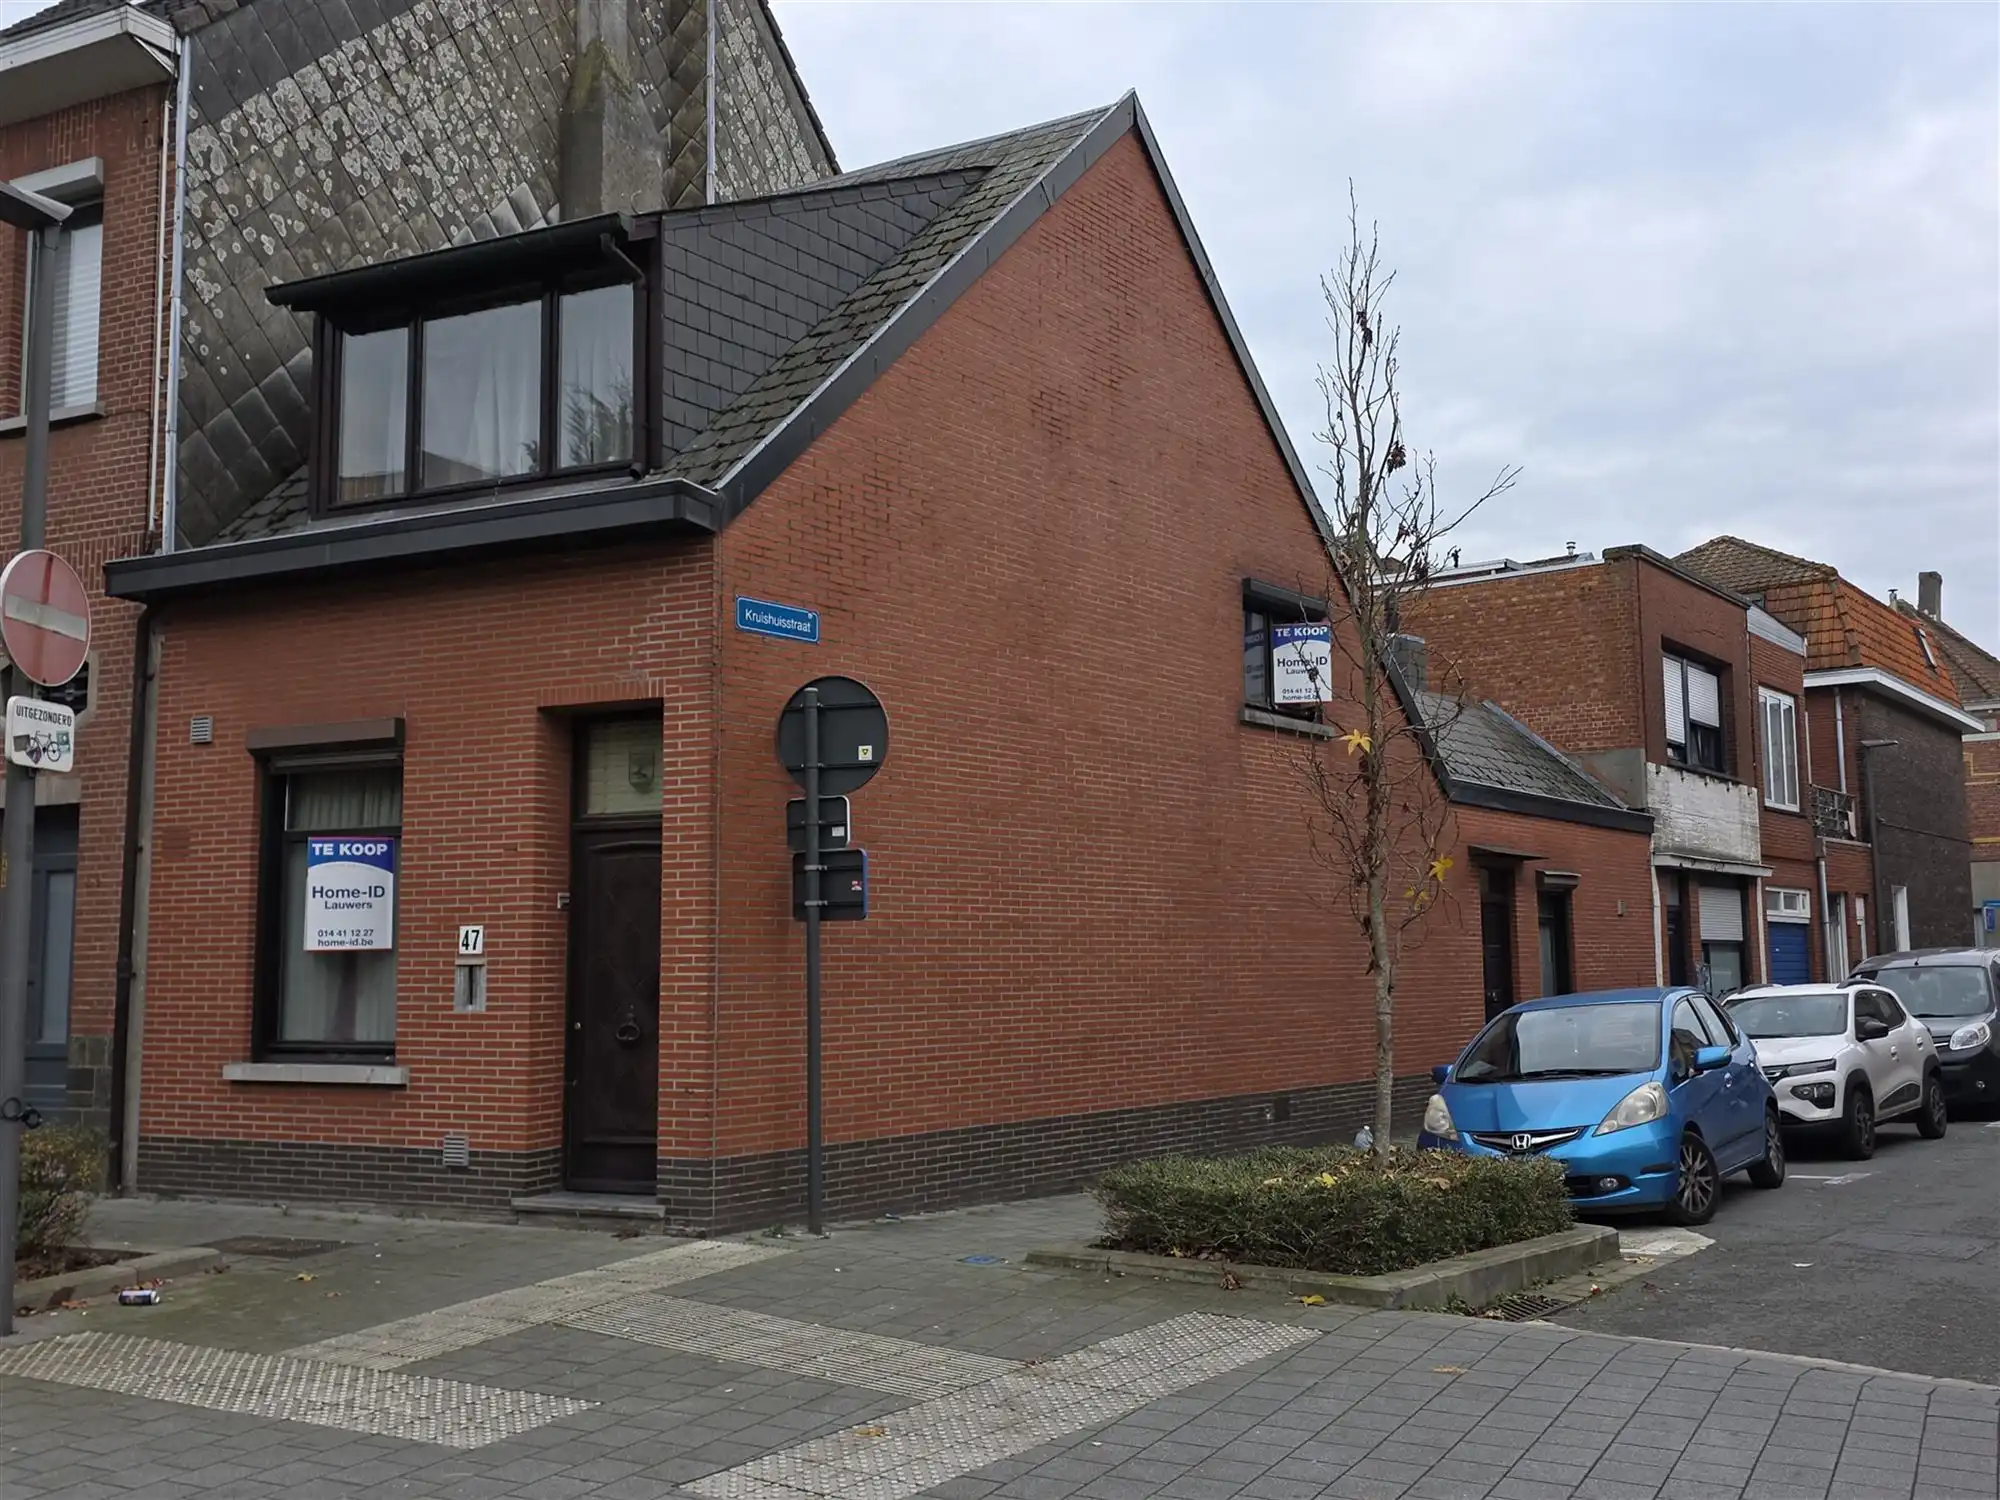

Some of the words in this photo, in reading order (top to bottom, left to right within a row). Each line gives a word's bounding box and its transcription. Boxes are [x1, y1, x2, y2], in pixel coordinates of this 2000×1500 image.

[745, 608, 811, 633] Kruishuisstraat
[1275, 628, 1290, 637] TE
[1294, 626, 1328, 637] KOOP
[16, 704, 72, 727] UITGEZONDERD
[311, 843, 335, 856] TE
[339, 843, 388, 856] KOOP
[312, 885, 386, 899] Home-ID
[324, 900, 373, 910] Lauwers
[317, 929, 335, 938] 014
[336, 929, 347, 937] 41
[351, 929, 361, 937] 12
[363, 929, 374, 937] 27
[461, 929, 480, 951] 47
[317, 938, 374, 948] home-id.be
